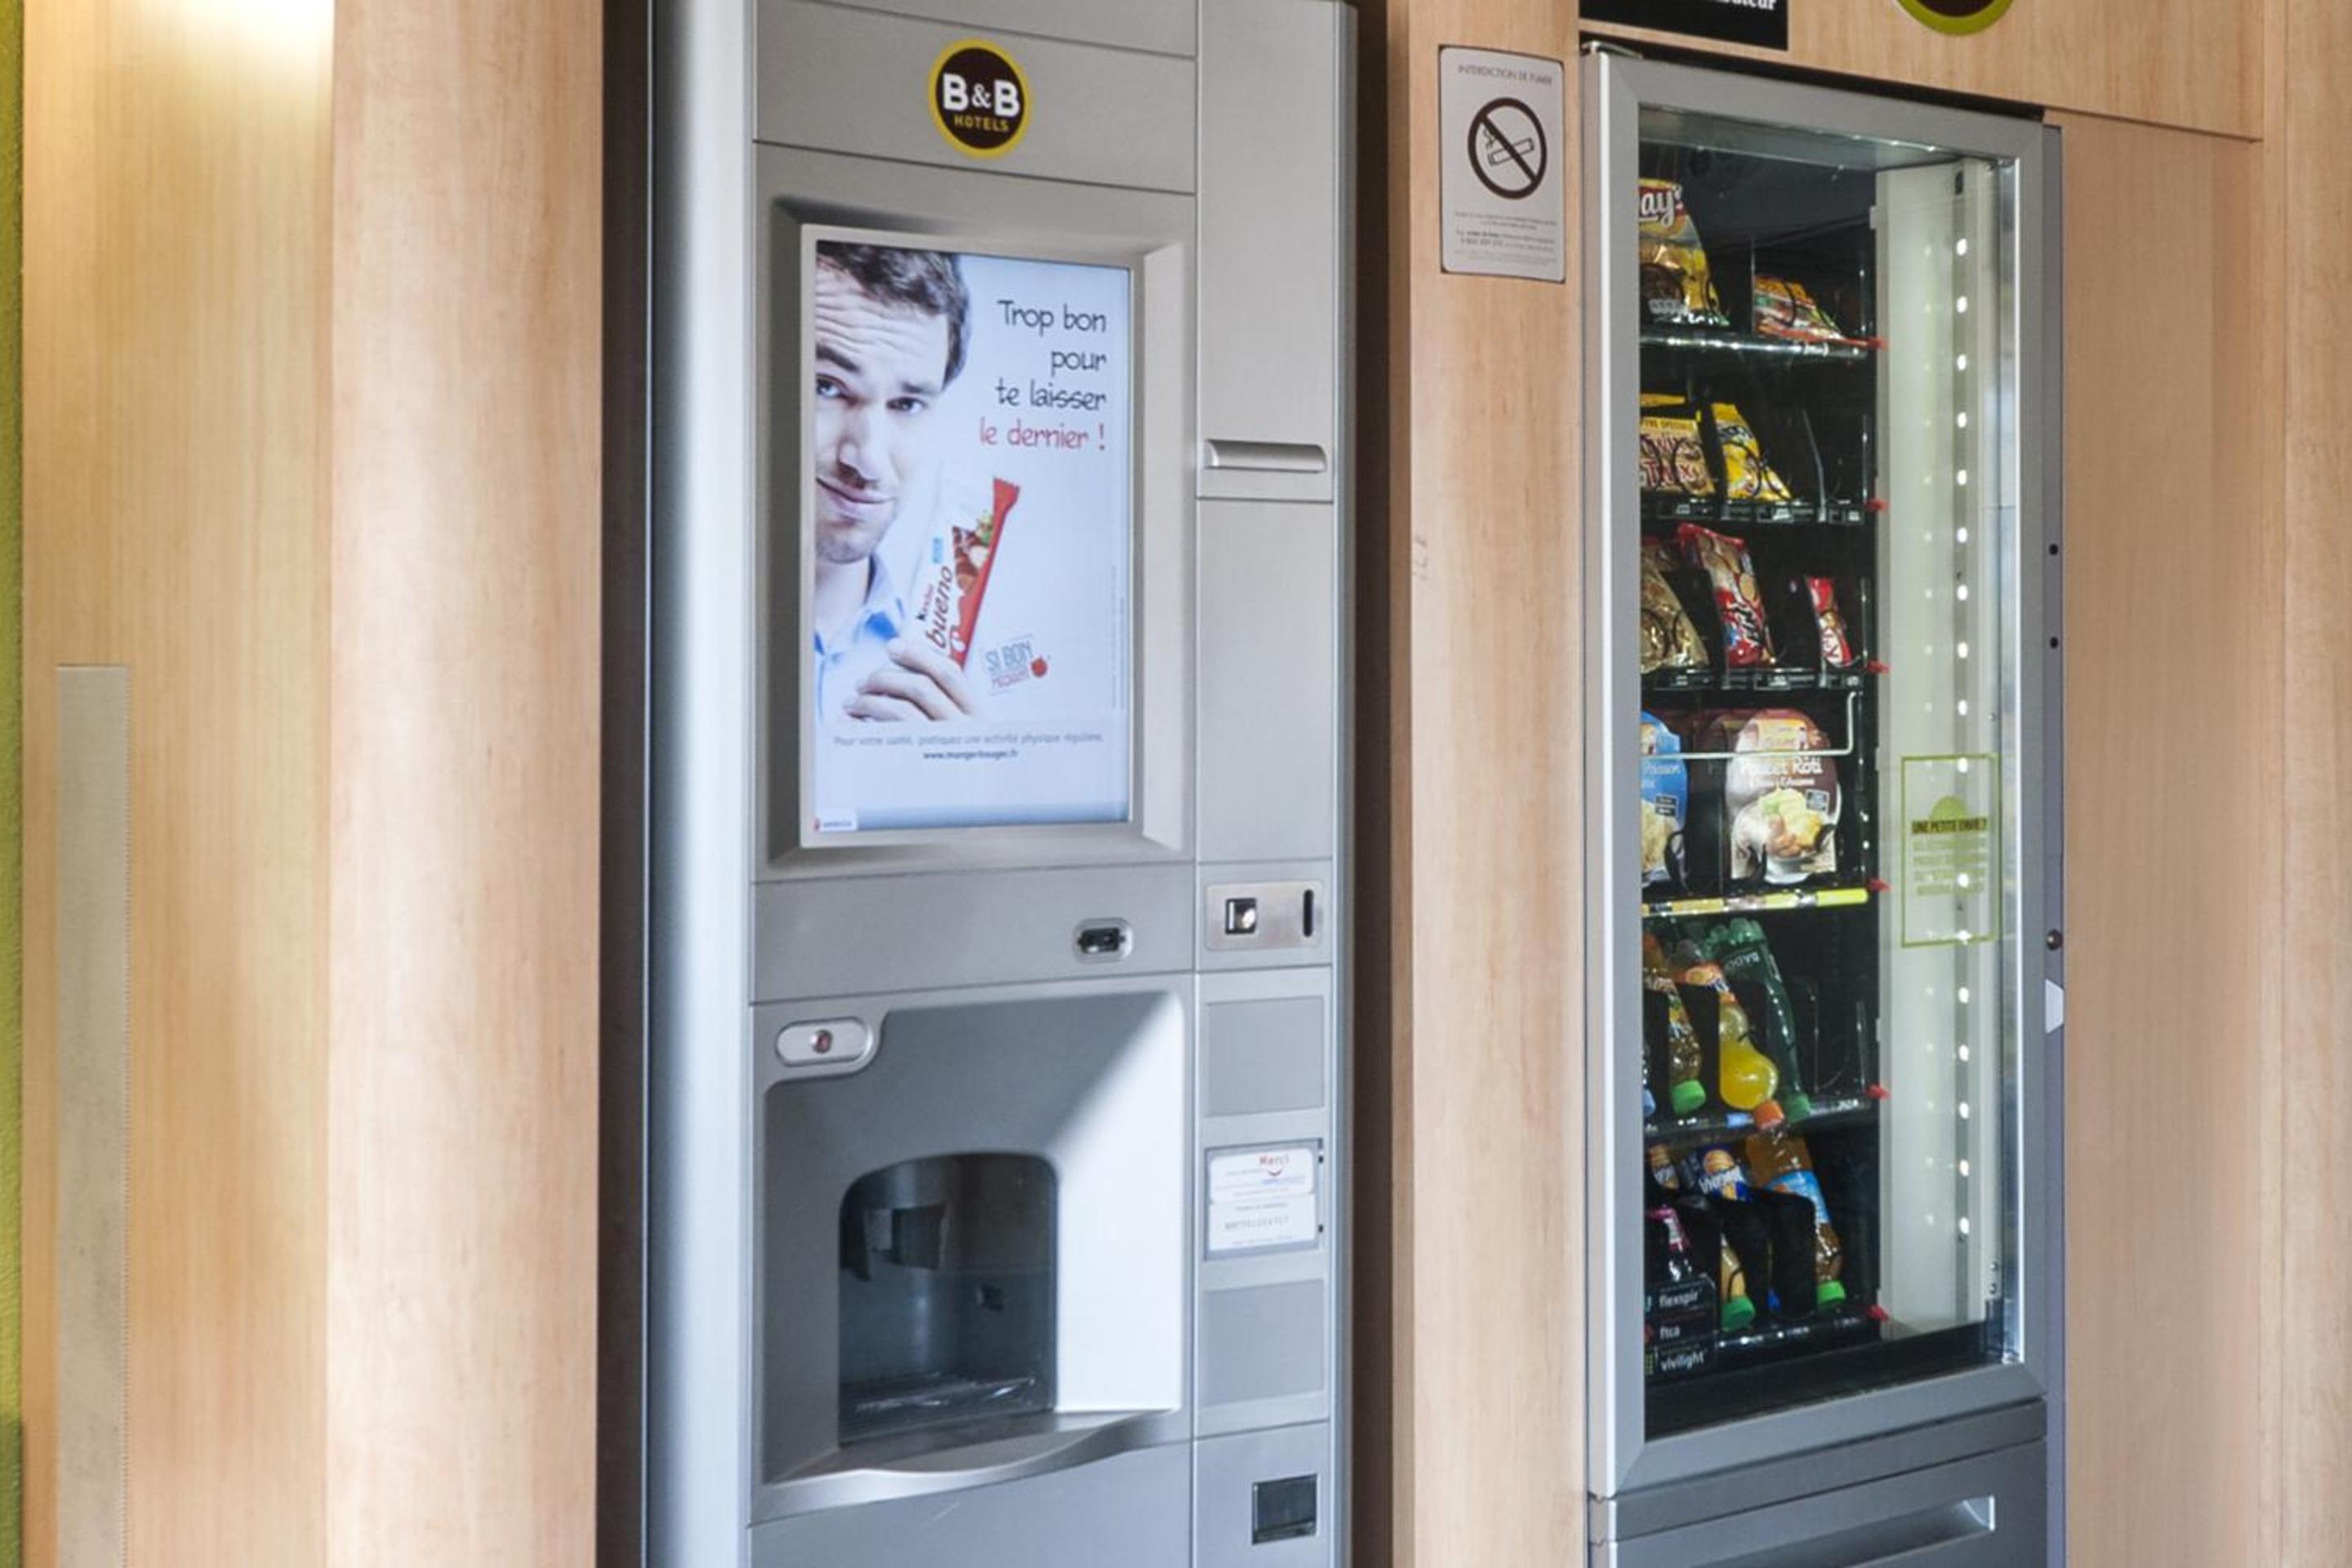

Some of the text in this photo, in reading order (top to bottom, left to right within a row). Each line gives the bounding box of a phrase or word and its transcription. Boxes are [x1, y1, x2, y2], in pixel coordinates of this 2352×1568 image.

[942, 73, 1020, 118] B&B
[954, 114, 1009, 131] HOTELS
[997, 300, 1106, 336] Trop bon
[1051, 351, 1107, 376] pour
[996, 377, 1106, 410] te laisser
[980, 416, 997, 444] le
[1007, 418, 1089, 448] dernier
[926, 566, 953, 649] bueno
[1912, 820, 1928, 834] UNE
